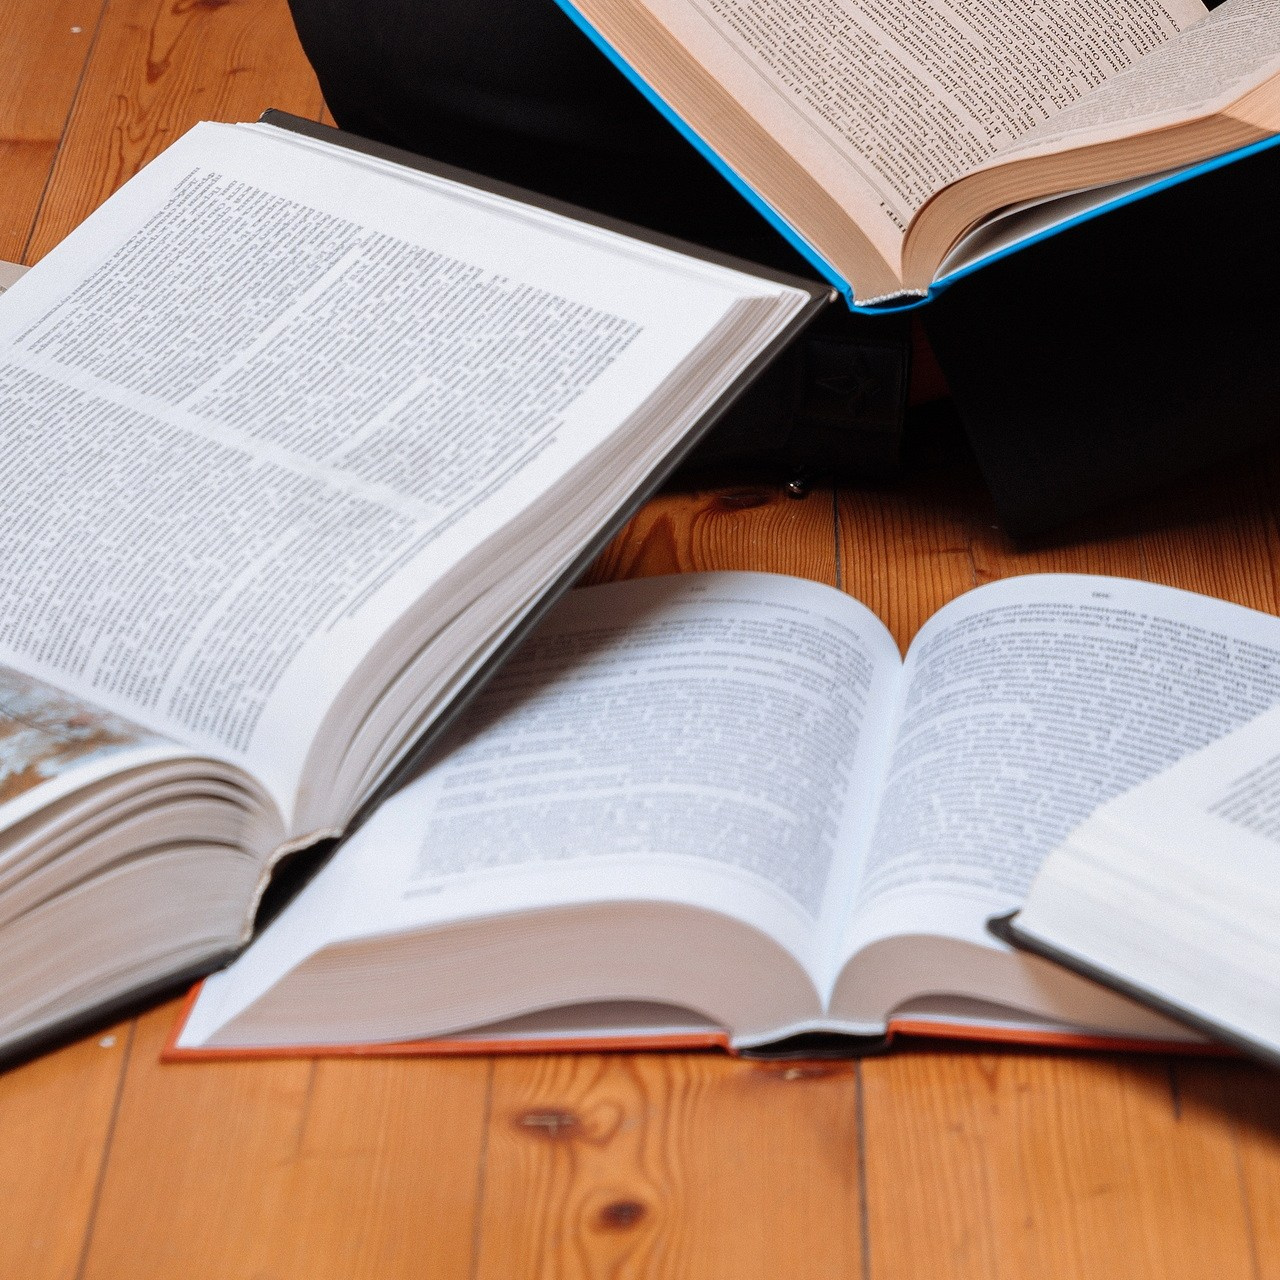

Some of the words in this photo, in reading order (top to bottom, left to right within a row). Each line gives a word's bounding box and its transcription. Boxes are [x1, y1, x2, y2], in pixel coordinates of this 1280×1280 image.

[934, 10, 967, 40] Анабара
[954, 8, 1003, 55] путешествия
[980, 12, 1014, 45] Соколов
[1013, 12, 1046, 44] времени
[1063, 7, 1087, 33] места,
[1084, 0, 1125, 43] Результаты
[859, 5, 927, 66] дальневосточных
[886, 20, 932, 61] Анциферов
[947, 33, 979, 64] Японии
[966, 41, 992, 66] Семен
[1003, 55, 1026, 79] время
[1014, 44, 1042, 74] Кузьма
[1045, 44, 1066, 66] этого
[931, 61, 962, 89] Данила
[932, 73, 953, 94] Петр
[985, 70, 1020, 106] сведения
[991, 66, 1010, 84] году
[1025, 78, 1039, 93] это
[1041, 74, 1059, 92] году
[959, 90, 978, 107] году
[1008, 83, 1026, 103] 1713
[953, 93, 983, 125] забывал
[977, 107, 995, 126] 1711
